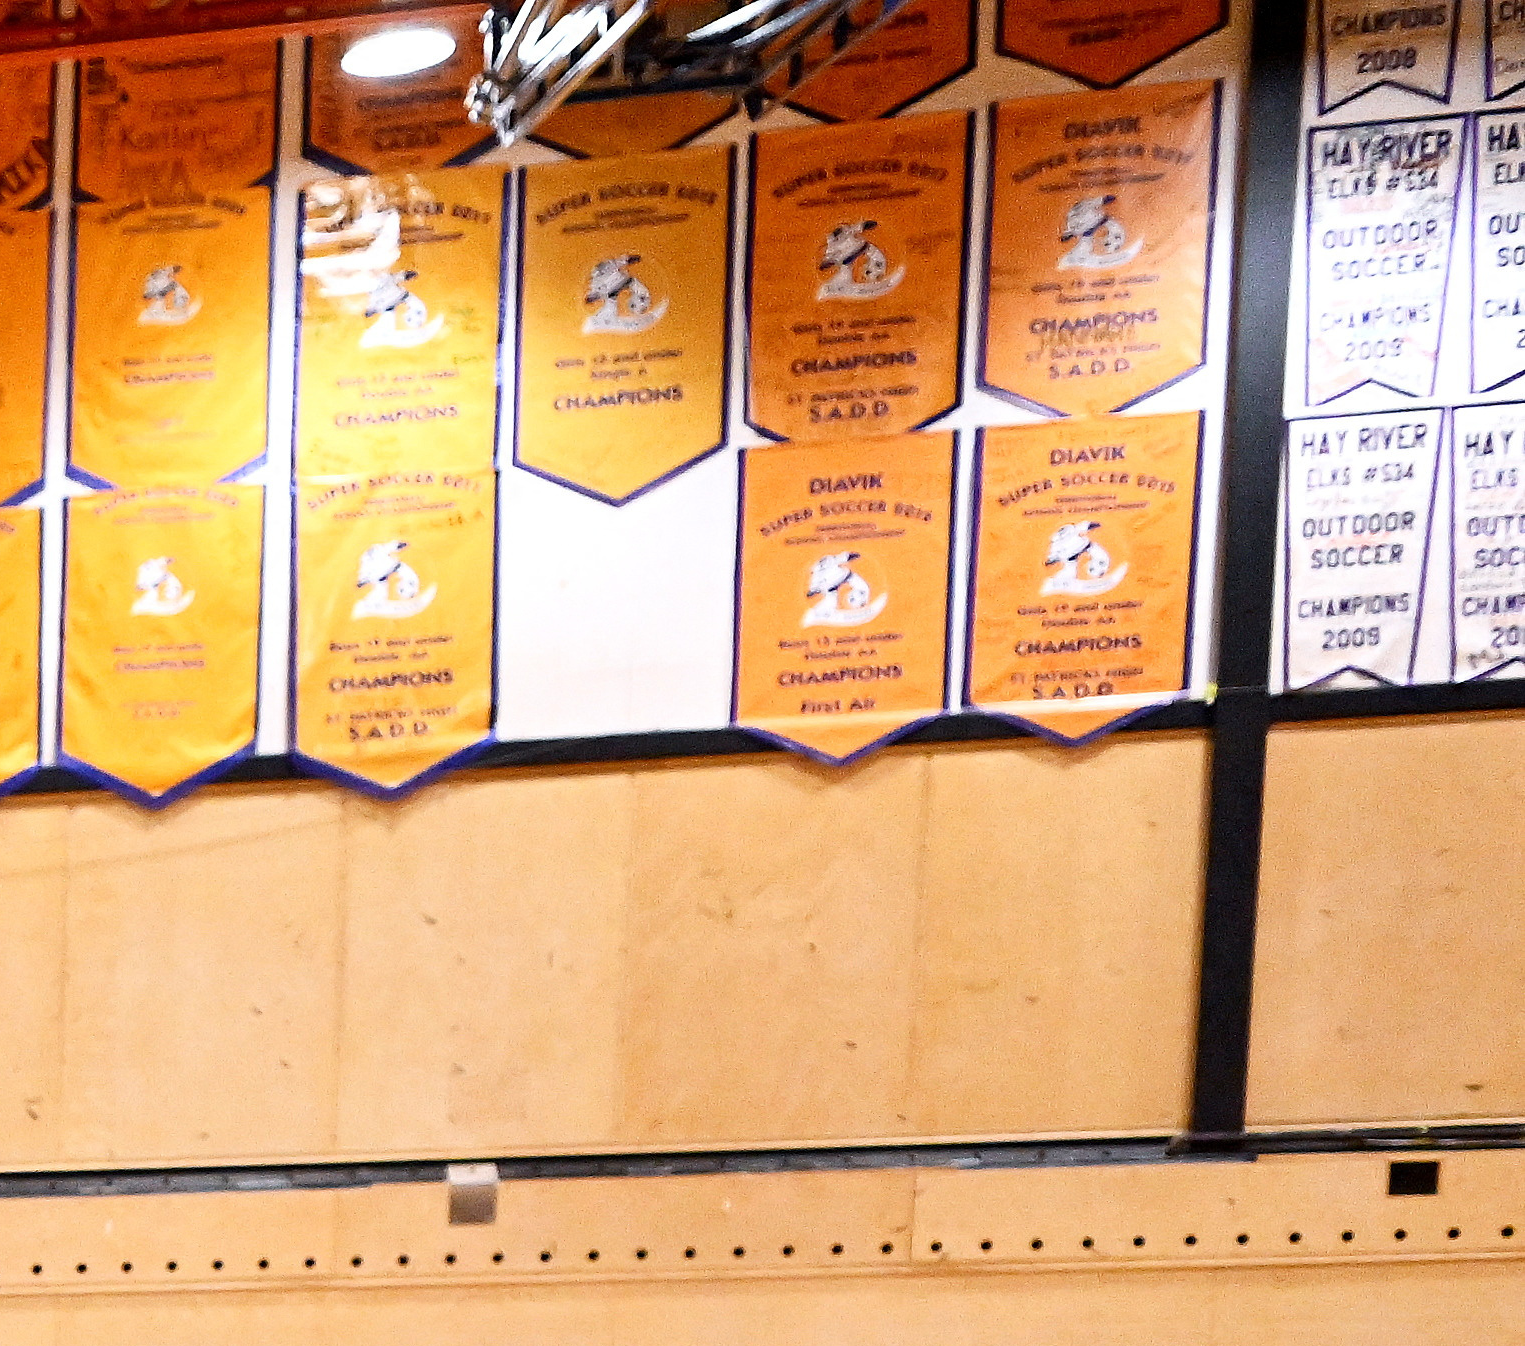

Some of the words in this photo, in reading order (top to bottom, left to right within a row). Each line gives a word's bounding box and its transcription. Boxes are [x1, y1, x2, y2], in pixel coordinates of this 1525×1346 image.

[1064, 116, 1140, 139] DIAVIK
[1322, 138, 1371, 167] HAY
[1377, 129, 1452, 166] RIVER
[1012, 154, 1068, 183] SUPER
[1076, 145, 1145, 161] SOCCER
[773, 169, 827, 199] SUPER
[832, 158, 903, 176] SOCCER
[536, 192, 591, 225] SUPER
[598, 182, 670, 201] SOCCER
[1323, 219, 1439, 249] OUTDOOR
[1332, 253, 1427, 281] SOCCER
[1029, 308, 1159, 335] CHAMPIONS
[1321, 302, 1431, 331] CHAMPIONS
[791, 351, 917, 376] CHAMPIONS
[553, 386, 683, 411] CHAMPIONS
[334, 404, 459, 428] CHAMPIONS
[1301, 431, 1348, 457] HAY
[1358, 423, 1426, 452] RIVER
[1464, 430, 1514, 457] HAY
[1050, 444, 1125, 467] DIAVIK
[307, 481, 360, 511] SUPER
[368, 473, 434, 489] SOCCER
[809, 472, 884, 495] DIAVIK
[998, 477, 1053, 507] SUPER
[1060, 471, 1130, 488] SOCCER
[760, 507, 813, 537] SUPER
[820, 500, 887, 516] SOCCER
[1303, 511, 1416, 539] OUTDOOR
[1311, 544, 1404, 569] SOCCER
[1298, 593, 1409, 618] CHAMPIONS
[1014, 633, 1142, 657] CHAMPIONS
[329, 668, 453, 693] CHAMPIONS
[778, 664, 903, 688] CHAMPIONS
[801, 700, 842, 714] First
